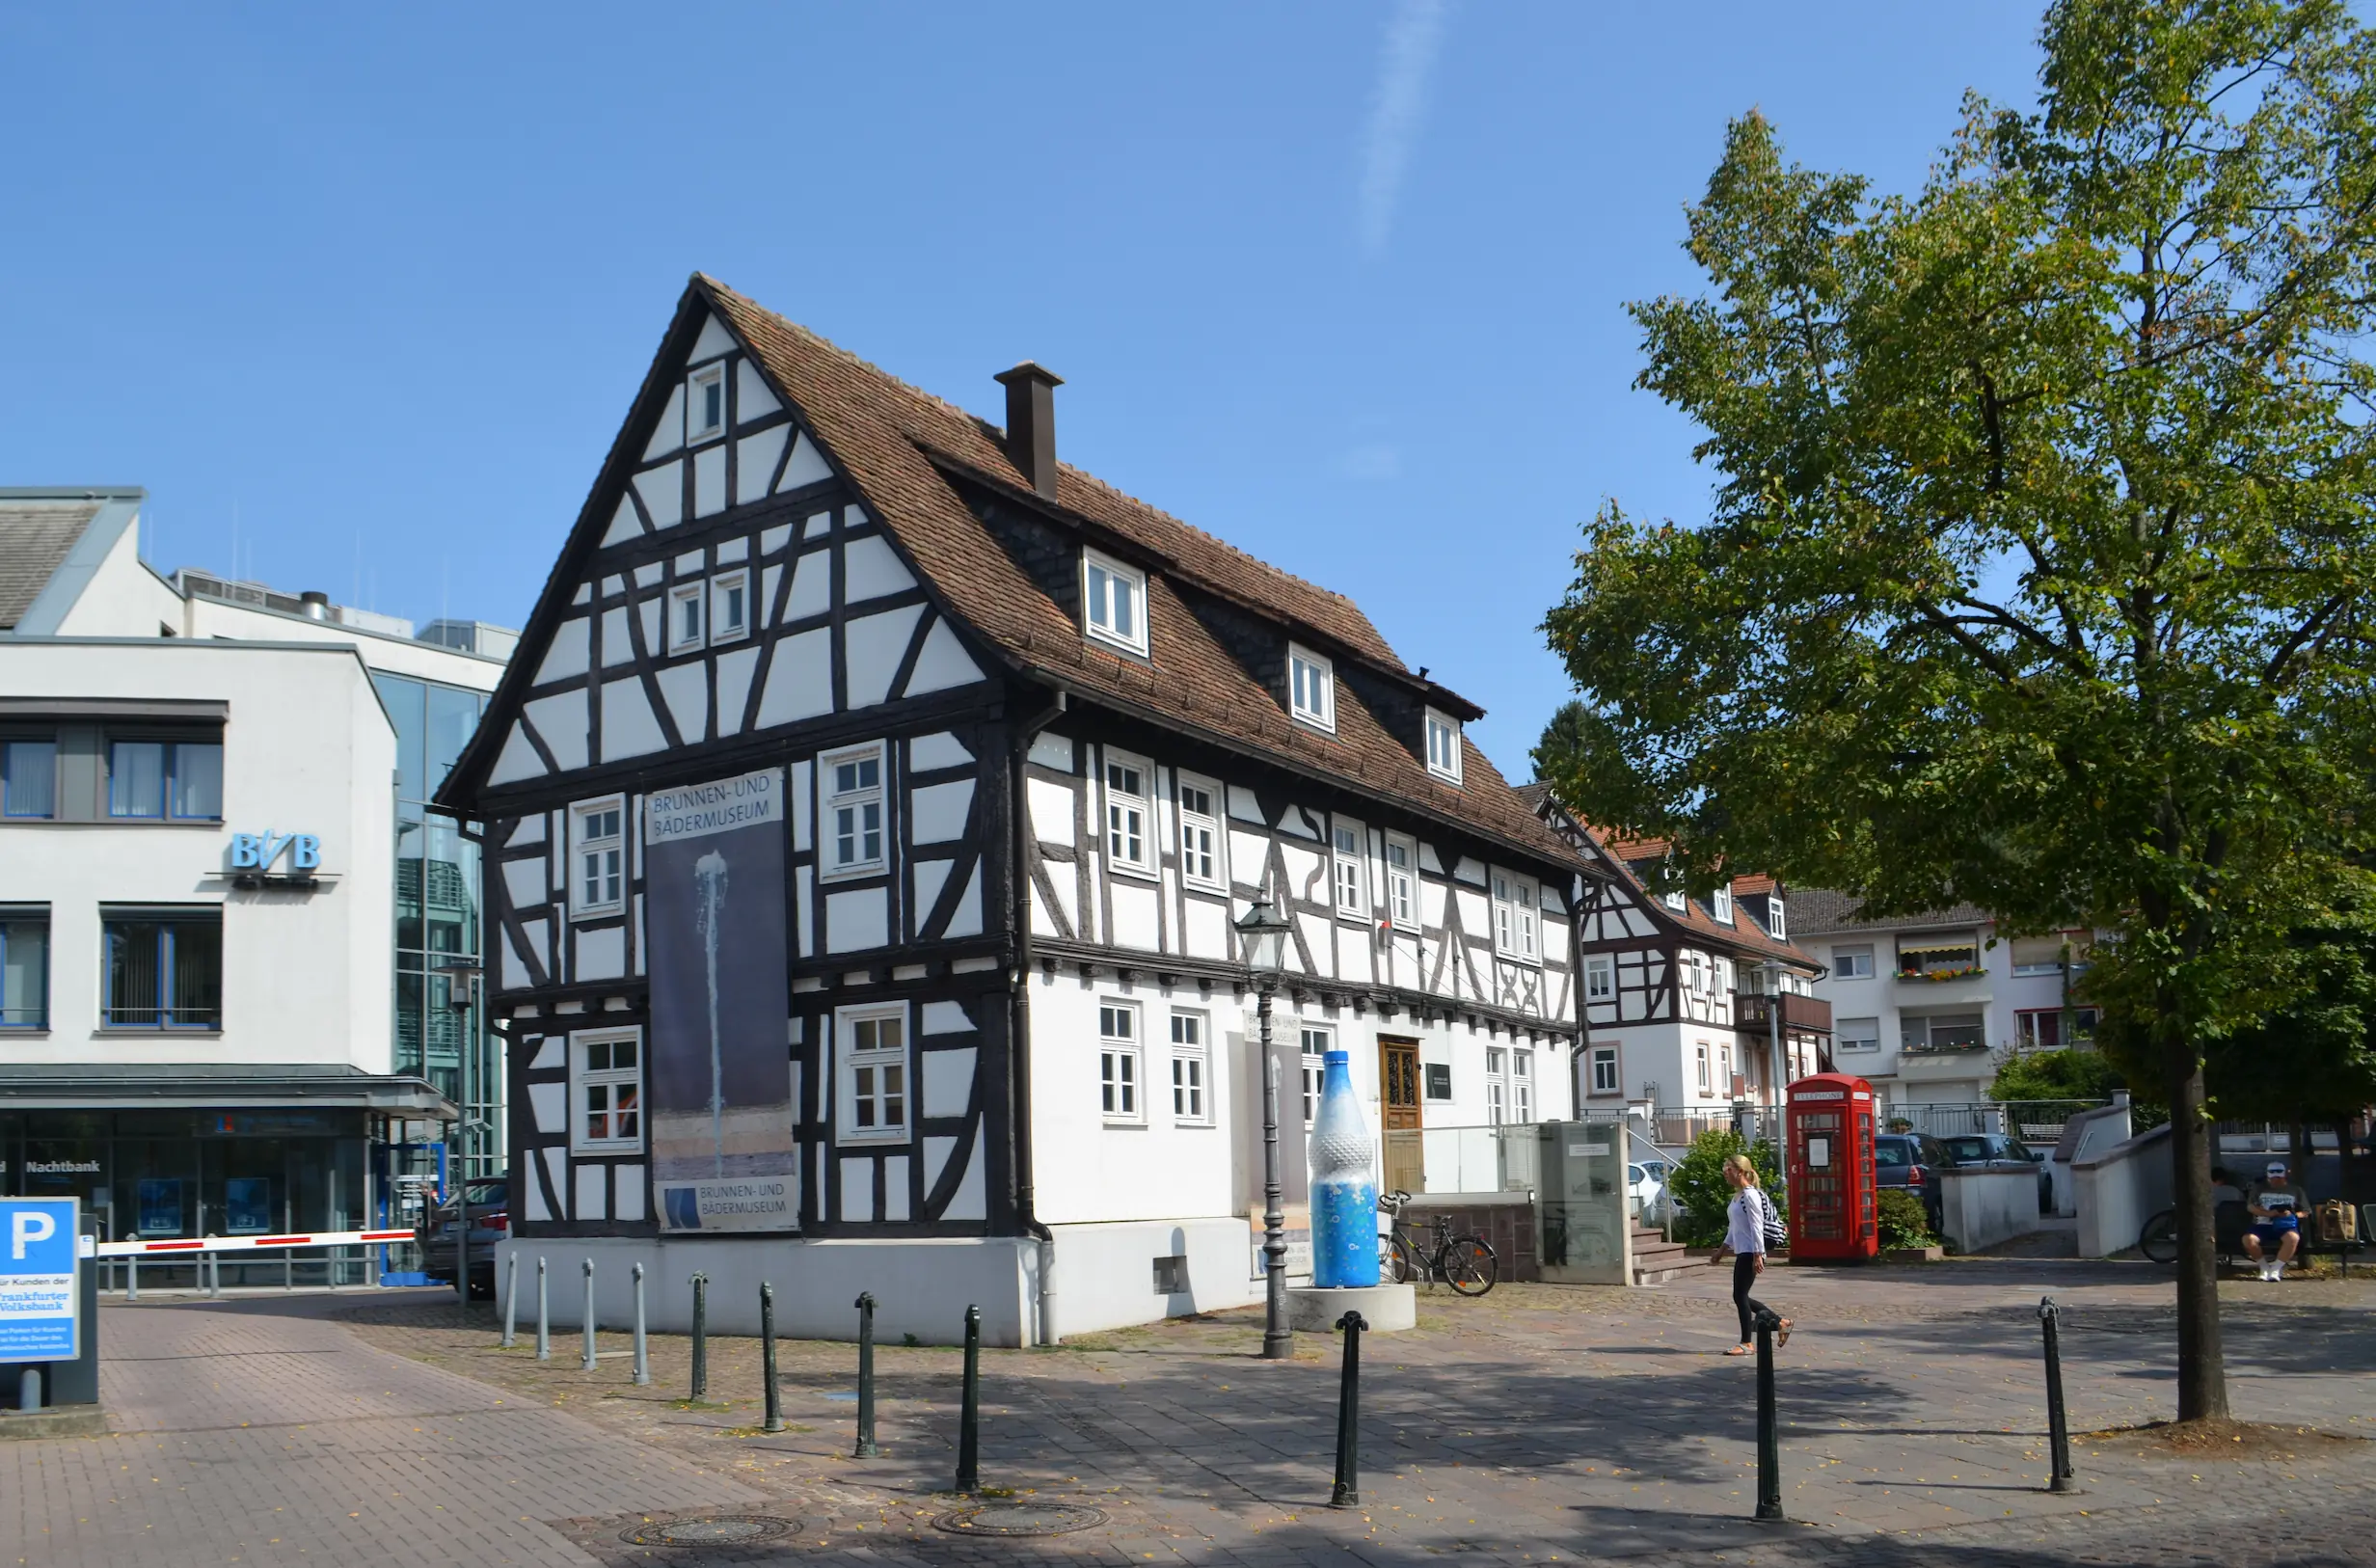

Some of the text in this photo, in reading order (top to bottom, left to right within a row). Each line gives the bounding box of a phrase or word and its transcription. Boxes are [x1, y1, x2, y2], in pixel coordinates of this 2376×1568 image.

[654, 775, 770, 813] BRUNNEN- UND
[655, 799, 769, 837] BÄDERMUSEUM
[1249, 1014, 1297, 1029] BRUEN- UND
[1248, 1027, 1297, 1042] BÄDMUSEUM
[1796, 1092, 1842, 1100] TELEPHONE
[26, 1160, 100, 1173] Nachtbank
[700, 1183, 785, 1199] BRUNNEN- UND
[702, 1200, 787, 1215] BÄDERMUSEUM
[13, 1212, 56, 1259] P
[0, 1292, 69, 1301] rankfurter
[0, 1302, 64, 1311] Volksbank
